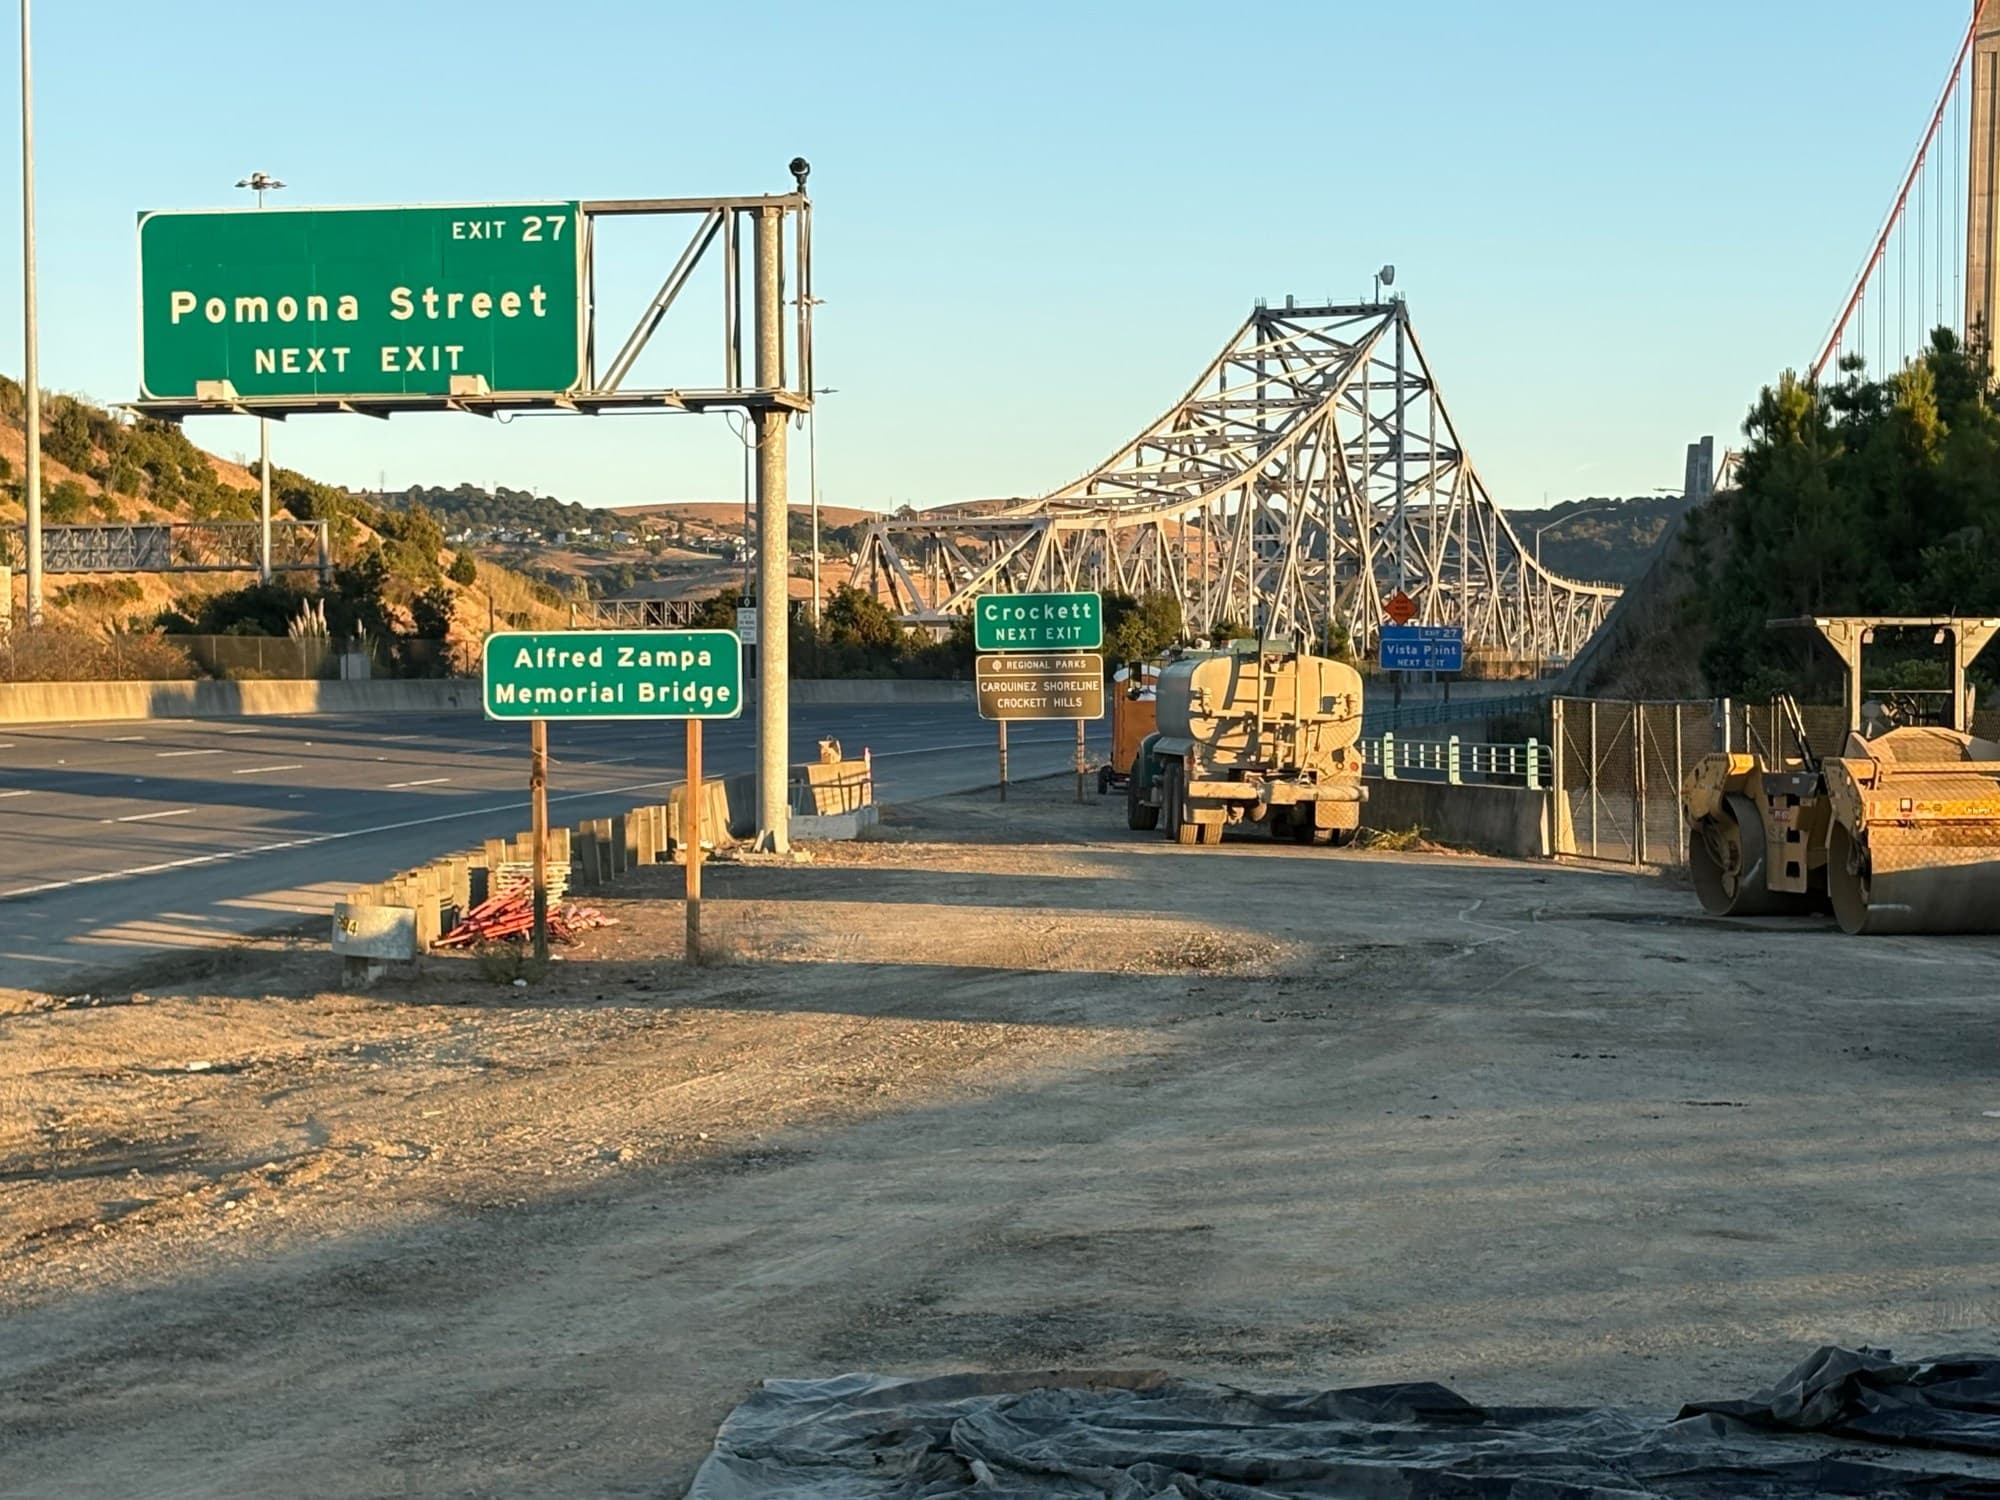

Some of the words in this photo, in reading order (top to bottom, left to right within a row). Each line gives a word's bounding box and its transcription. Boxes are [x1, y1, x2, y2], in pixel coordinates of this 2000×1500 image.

[452, 221, 506, 240] EXIT
[522, 216, 567, 242] 27
[171, 291, 359, 324] Pomona
[390, 284, 546, 320] Street
[255, 347, 351, 374] NEXT
[381, 345, 464, 372] EXIT
[985, 603, 1091, 621] Crockett
[996, 628, 1037, 641] NEXT
[1046, 626, 1082, 639] EXIT
[1443, 629, 1457, 638] 27
[1387, 644, 1418, 655] Vista
[514, 646, 603, 669] Alfred
[617, 647, 712, 671] Zampa
[1006, 660, 1051, 670] REGIONAL
[1055, 660, 1087, 669] PARKS
[1397, 659, 1420, 667] NEXT
[1424, 659, 1445, 667] EIT
[981, 682, 1037, 692] CARQUINEZ
[1043, 680, 1099, 691] SHORELINE
[496, 681, 624, 704] Memorial
[638, 681, 731, 708] Bridge
[997, 697, 1047, 708] CROCKETT
[1053, 697, 1082, 708] HILLS
